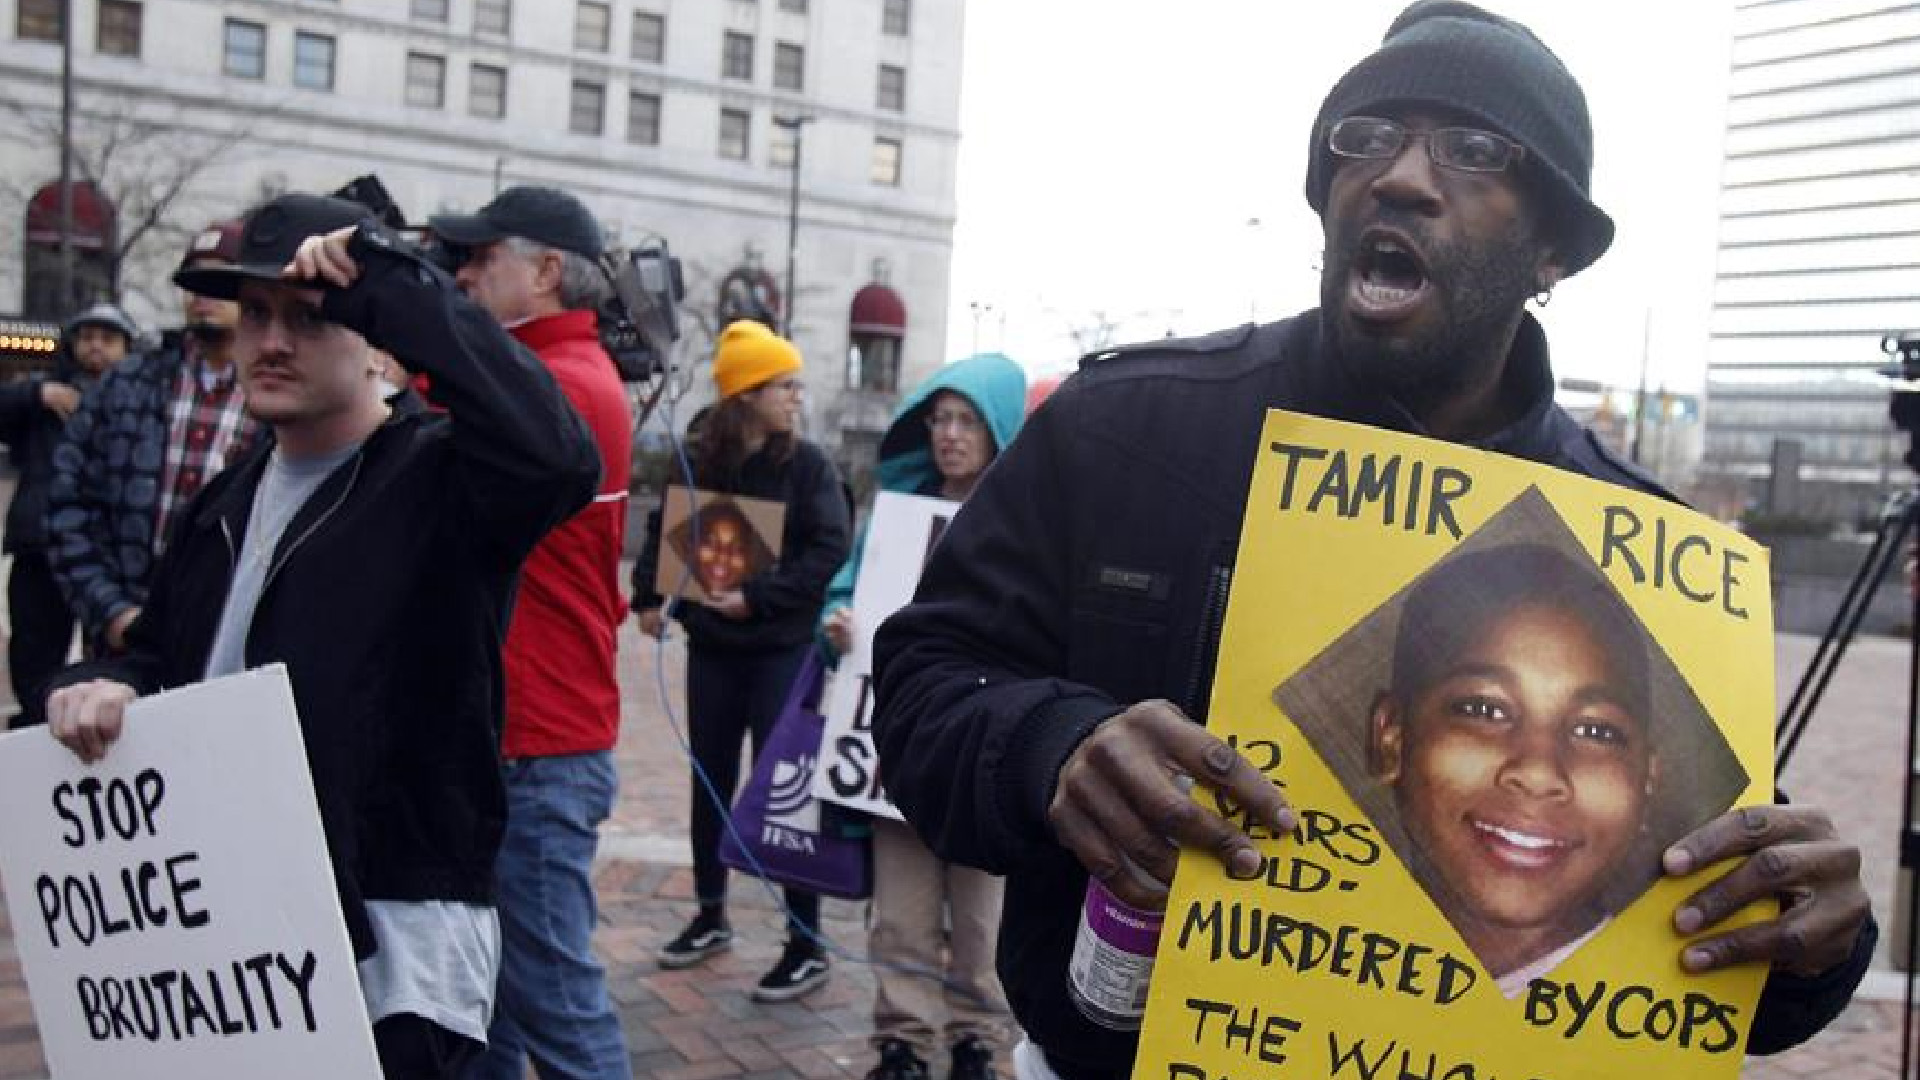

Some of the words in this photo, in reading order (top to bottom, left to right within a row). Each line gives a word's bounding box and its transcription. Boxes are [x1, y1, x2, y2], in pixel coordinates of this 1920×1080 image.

[1270, 441, 1472, 541] TAMIR
[1601, 505, 1750, 620] RICE
[1228, 735, 1287, 788] 2
[52, 768, 165, 848] STOP
[36, 852, 210, 947] POLICE
[77, 950, 317, 1041] BRUTALITY
[1176, 900, 1477, 1004] MURDERED
[1186, 998, 1302, 1064] THE
